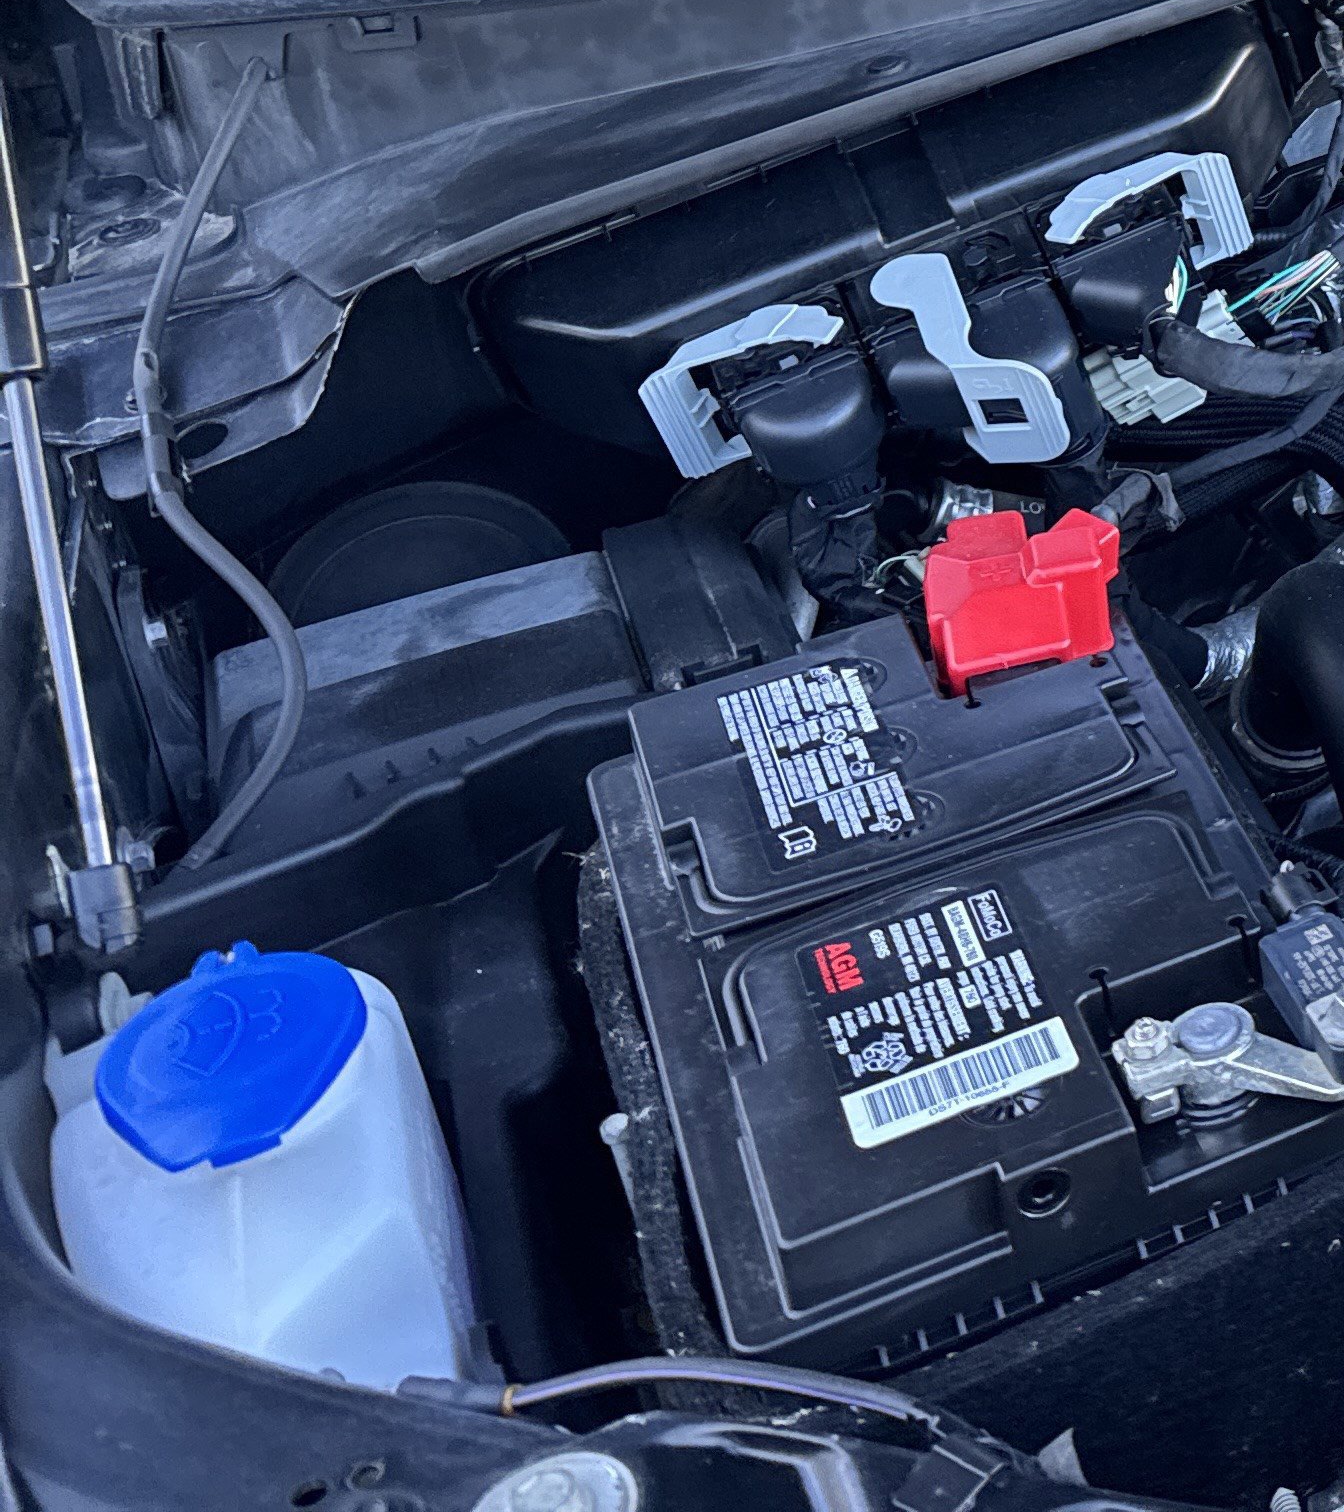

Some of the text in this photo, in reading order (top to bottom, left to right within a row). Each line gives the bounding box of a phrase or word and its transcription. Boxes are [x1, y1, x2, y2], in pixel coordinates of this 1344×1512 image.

[1019, 500, 1046, 515] LO
[976, 891, 1003, 938] FoMoCo
[825, 941, 865, 992] AGM
